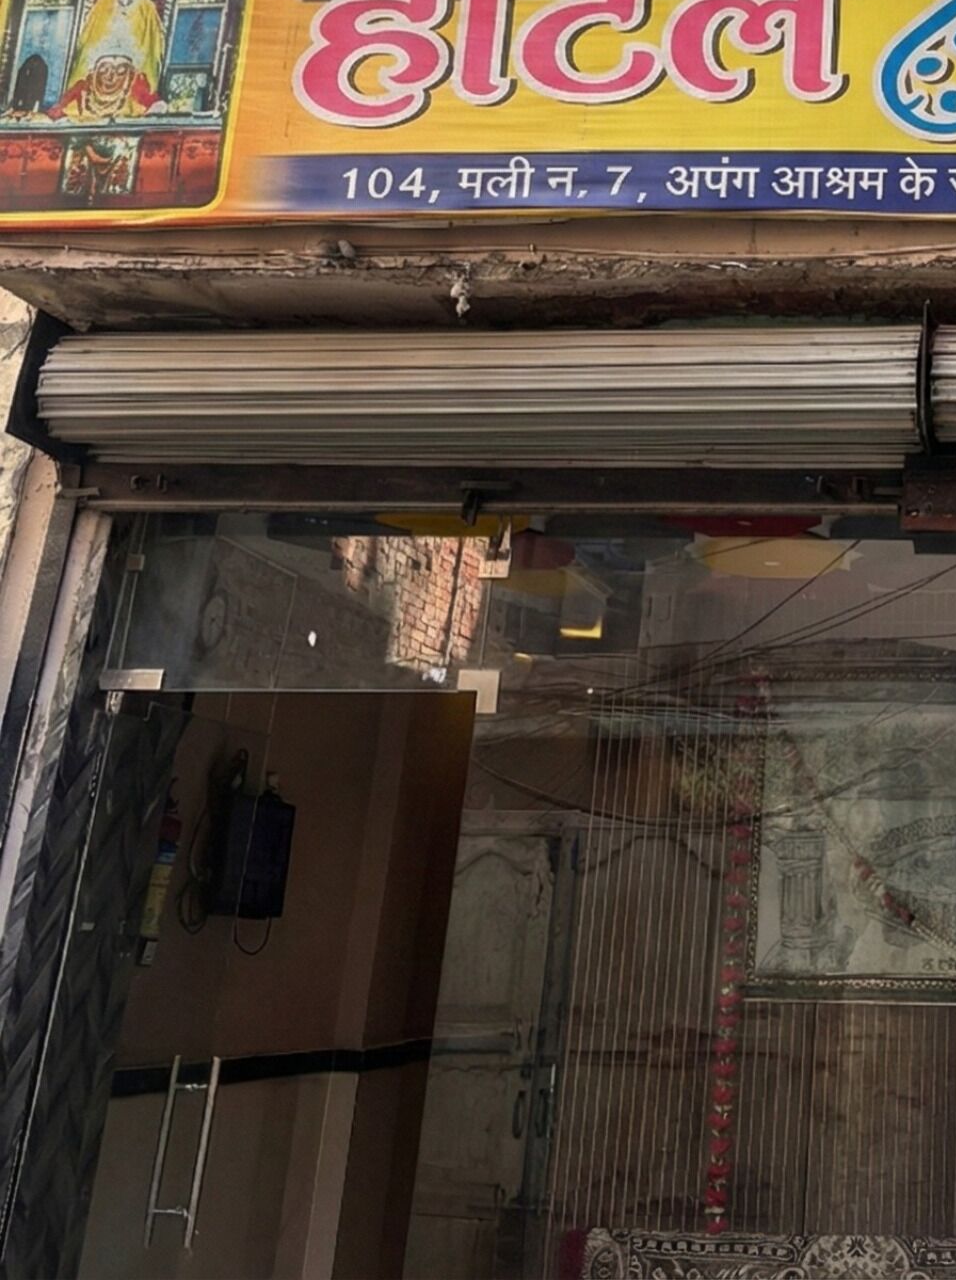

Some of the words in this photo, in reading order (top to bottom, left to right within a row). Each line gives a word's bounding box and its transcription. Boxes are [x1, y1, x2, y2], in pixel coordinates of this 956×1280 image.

[342, 167, 441, 204] 104,
[606, 166, 647, 204] 7,
[665, 155, 760, 198] अपंग
[771, 166, 888, 200] आश्रम
[899, 156, 938, 200] के
